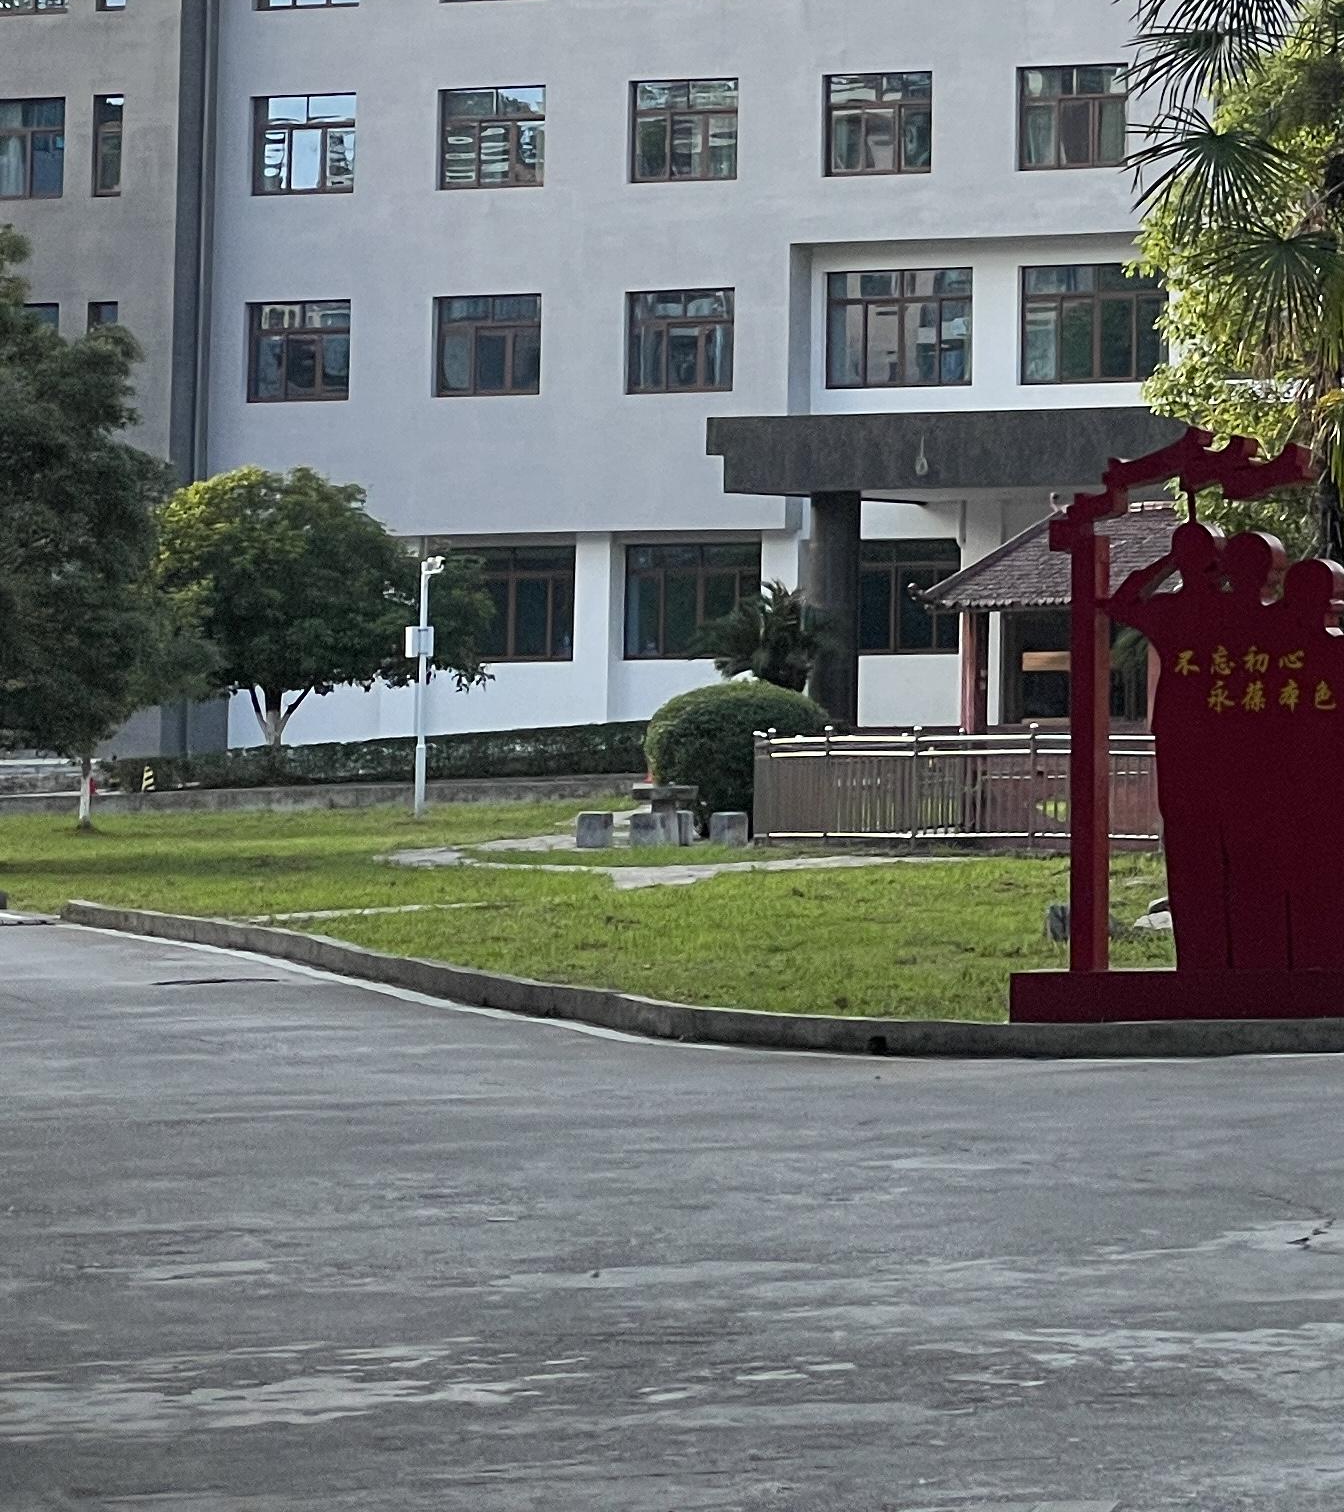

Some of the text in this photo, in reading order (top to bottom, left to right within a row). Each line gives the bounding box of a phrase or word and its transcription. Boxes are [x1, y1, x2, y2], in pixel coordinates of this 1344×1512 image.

[1174, 644, 1305, 676] 不忘初心
[1206, 678, 1338, 714] 永葆本色
